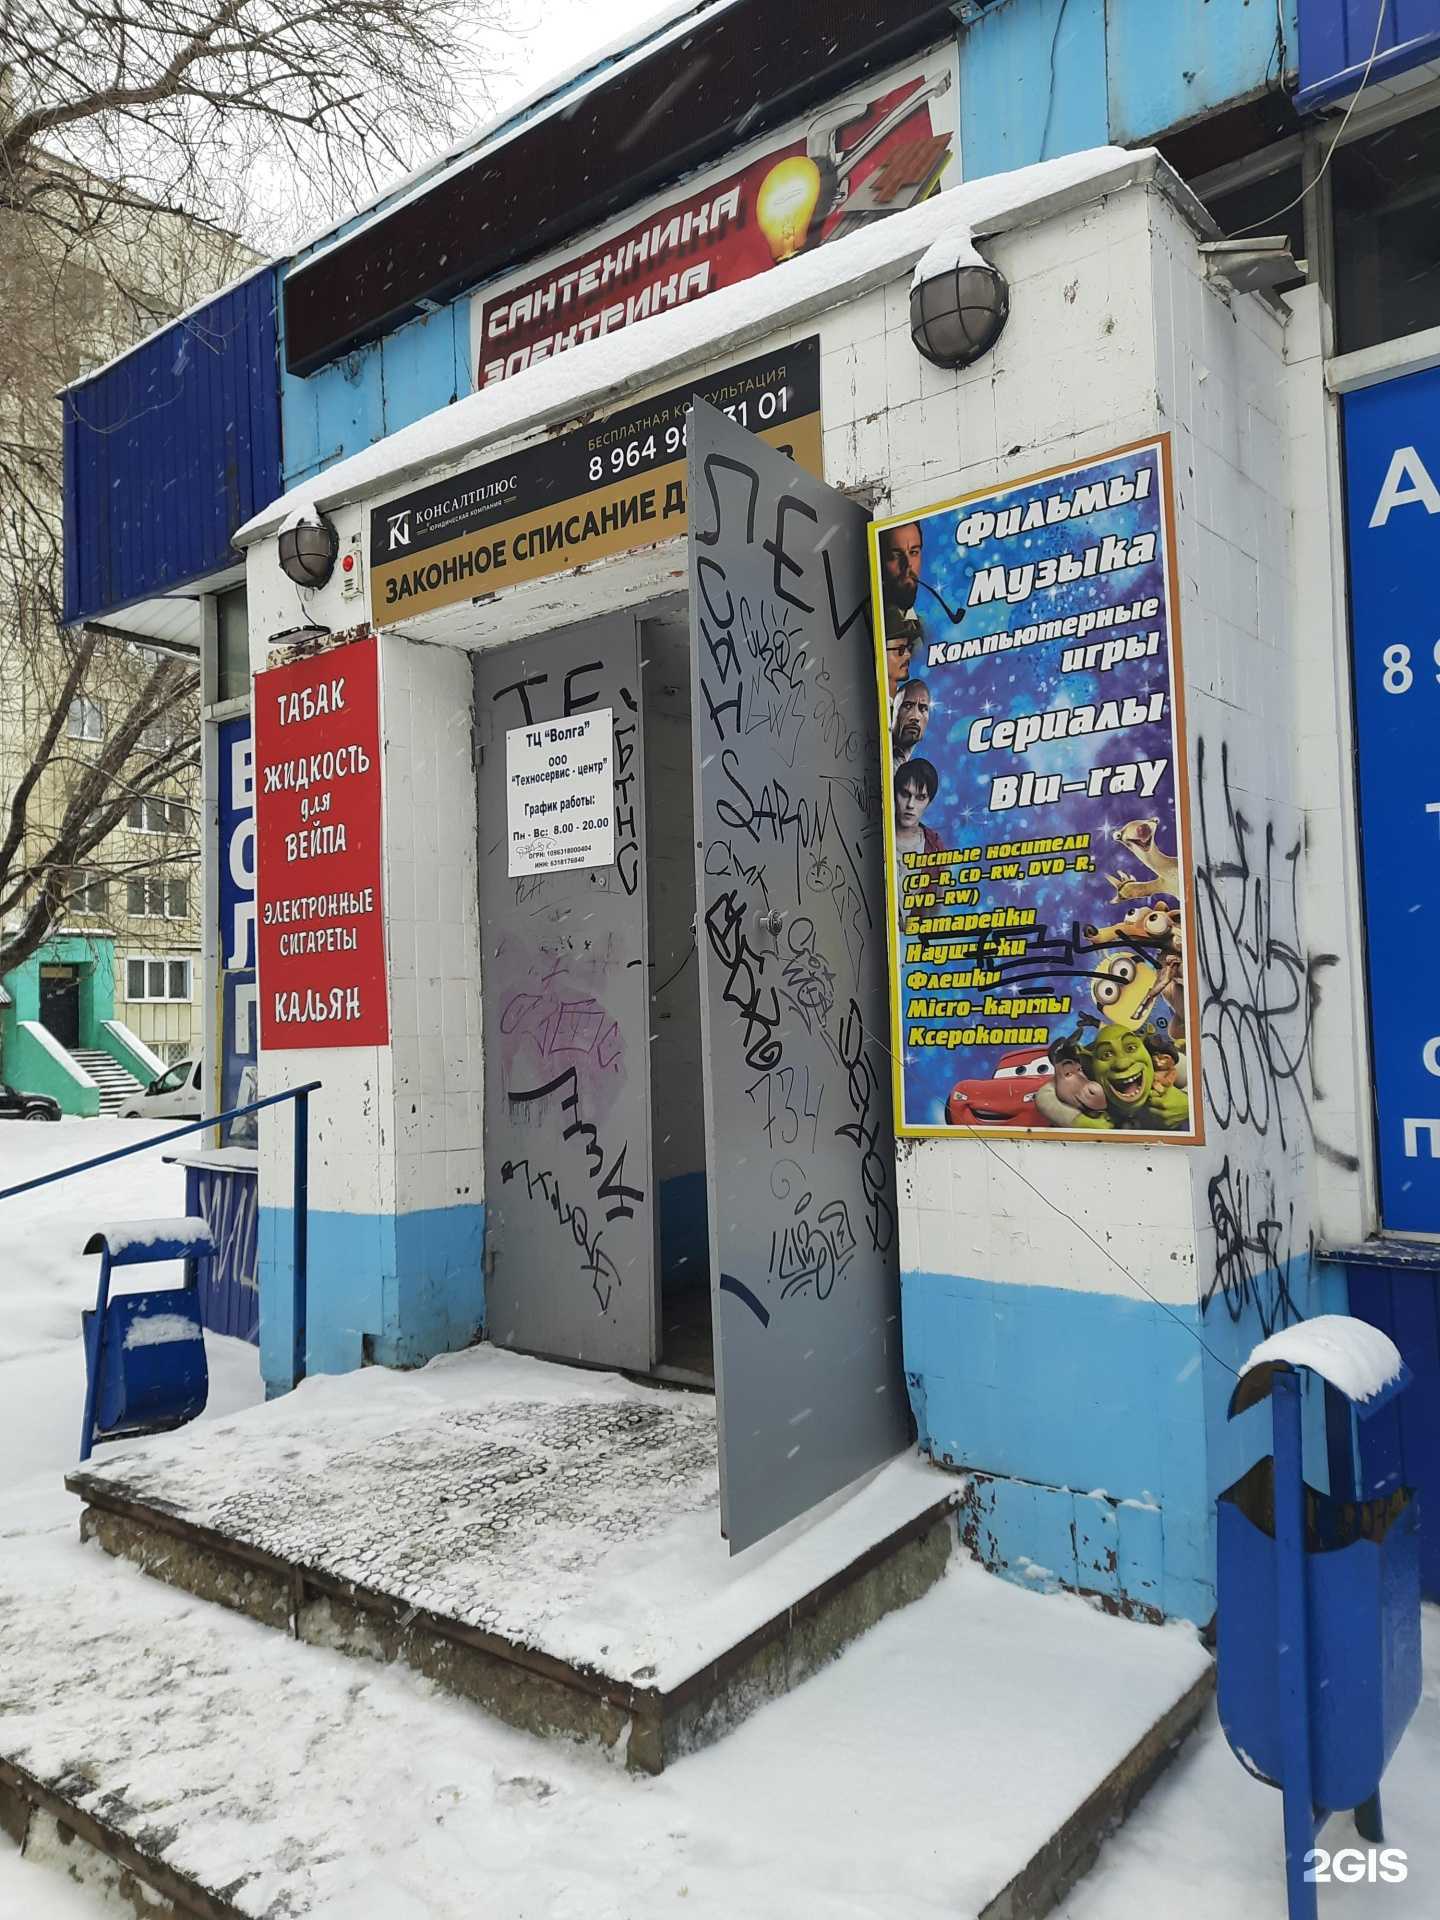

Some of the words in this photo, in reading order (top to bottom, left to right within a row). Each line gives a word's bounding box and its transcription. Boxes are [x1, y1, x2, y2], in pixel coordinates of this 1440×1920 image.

[488, 186, 742, 338] САНТЕХНИКА
[588, 408, 670, 451] БЕСПЛАТНАЯ
[674, 366, 787, 420] КОСУЛЬТАЦИЯ
[588, 456, 603, 481] 8
[610, 435, 657, 473] 964
[758, 386, 788, 420] 01
[416, 475, 518, 524] КОНСАЛТПЛЮС
[429, 512, 469, 531] ЮРИДИЧЕСКАЯ
[470, 500, 502, 516] КОМПАНИЯ
[956, 468, 1152, 547] Фильмы
[385, 540, 507, 604] ЗАКОННОЕ
[512, 488, 657, 561] СПИСАНИЕ
[967, 531, 1156, 608] Музыка
[927, 597, 1159, 667] Компьютерные
[1061, 631, 1160, 674] игры
[1382, 643, 1413, 694] 8
[277, 677, 346, 727] ТАБАК
[526, 731, 542, 748] ТЦ
[967, 692, 1164, 754] Сериалы
[263, 744, 371, 793] ЖИДКОСТЬ
[549, 754, 568, 767] ООО
[989, 758, 1168, 812] Blu-ray
[300, 791, 332, 822] для
[524, 801, 558, 818] График
[560, 794, 595, 813] работы:
[284, 818, 347, 862] ВЕЙПА
[513, 831, 525, 841] Пн
[533, 828, 548, 838] Вс:
[553, 823, 574, 835] 8.00
[582, 818, 609, 831] 20.00
[903, 847, 981, 869] Чистые
[986, 833, 1091, 860] носители
[902, 871, 956, 893] (CD-R,
[959, 862, 1025, 884] CD-RW,
[1028, 855, 1096, 877] DVD-R,
[262, 888, 375, 925] ЭЛЕКТРОННЫЕ
[903, 889, 980, 910] DVD-RW)
[279, 925, 358, 956] СИГАРЕТЫ
[904, 907, 1037, 936] Батарейки
[907, 968, 1002, 990] Флешки
[274, 986, 362, 1024] КАЛЬЯН
[907, 995, 1072, 1019] Micro-карты
[908, 1025, 1049, 1049] Ксерокопия
